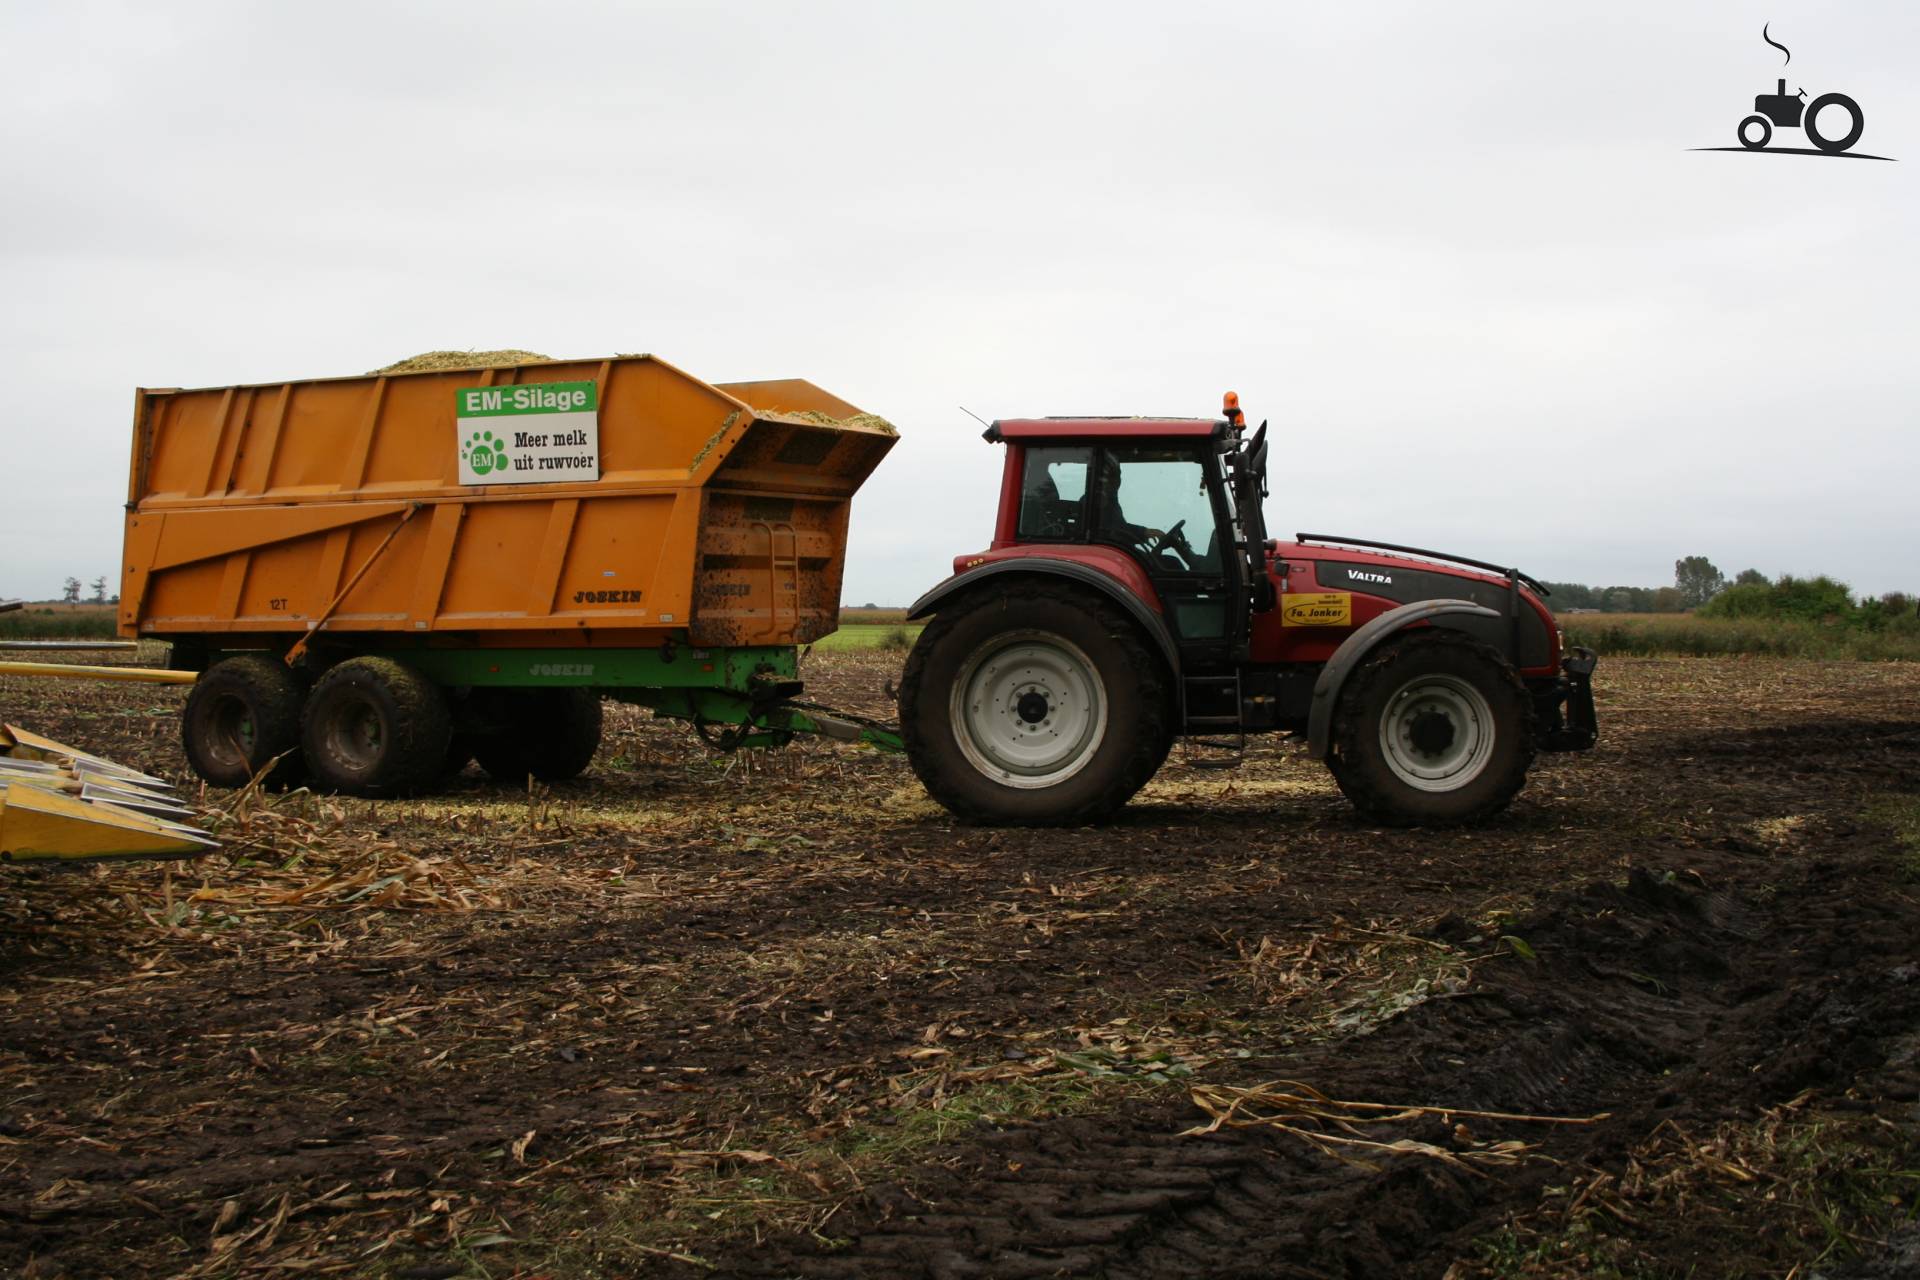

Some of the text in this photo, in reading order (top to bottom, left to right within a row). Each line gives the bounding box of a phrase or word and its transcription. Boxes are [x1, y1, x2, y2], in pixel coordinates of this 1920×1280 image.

[466, 389, 586, 411] EM-Silage
[515, 430, 587, 448] Meer melk
[472, 453, 492, 467] EM
[514, 454, 594, 470] uit ruwvoer
[1347, 569, 1392, 584] VALTRA
[573, 590, 642, 603] JOSKIN
[1308, 608, 1342, 617] Jonker
